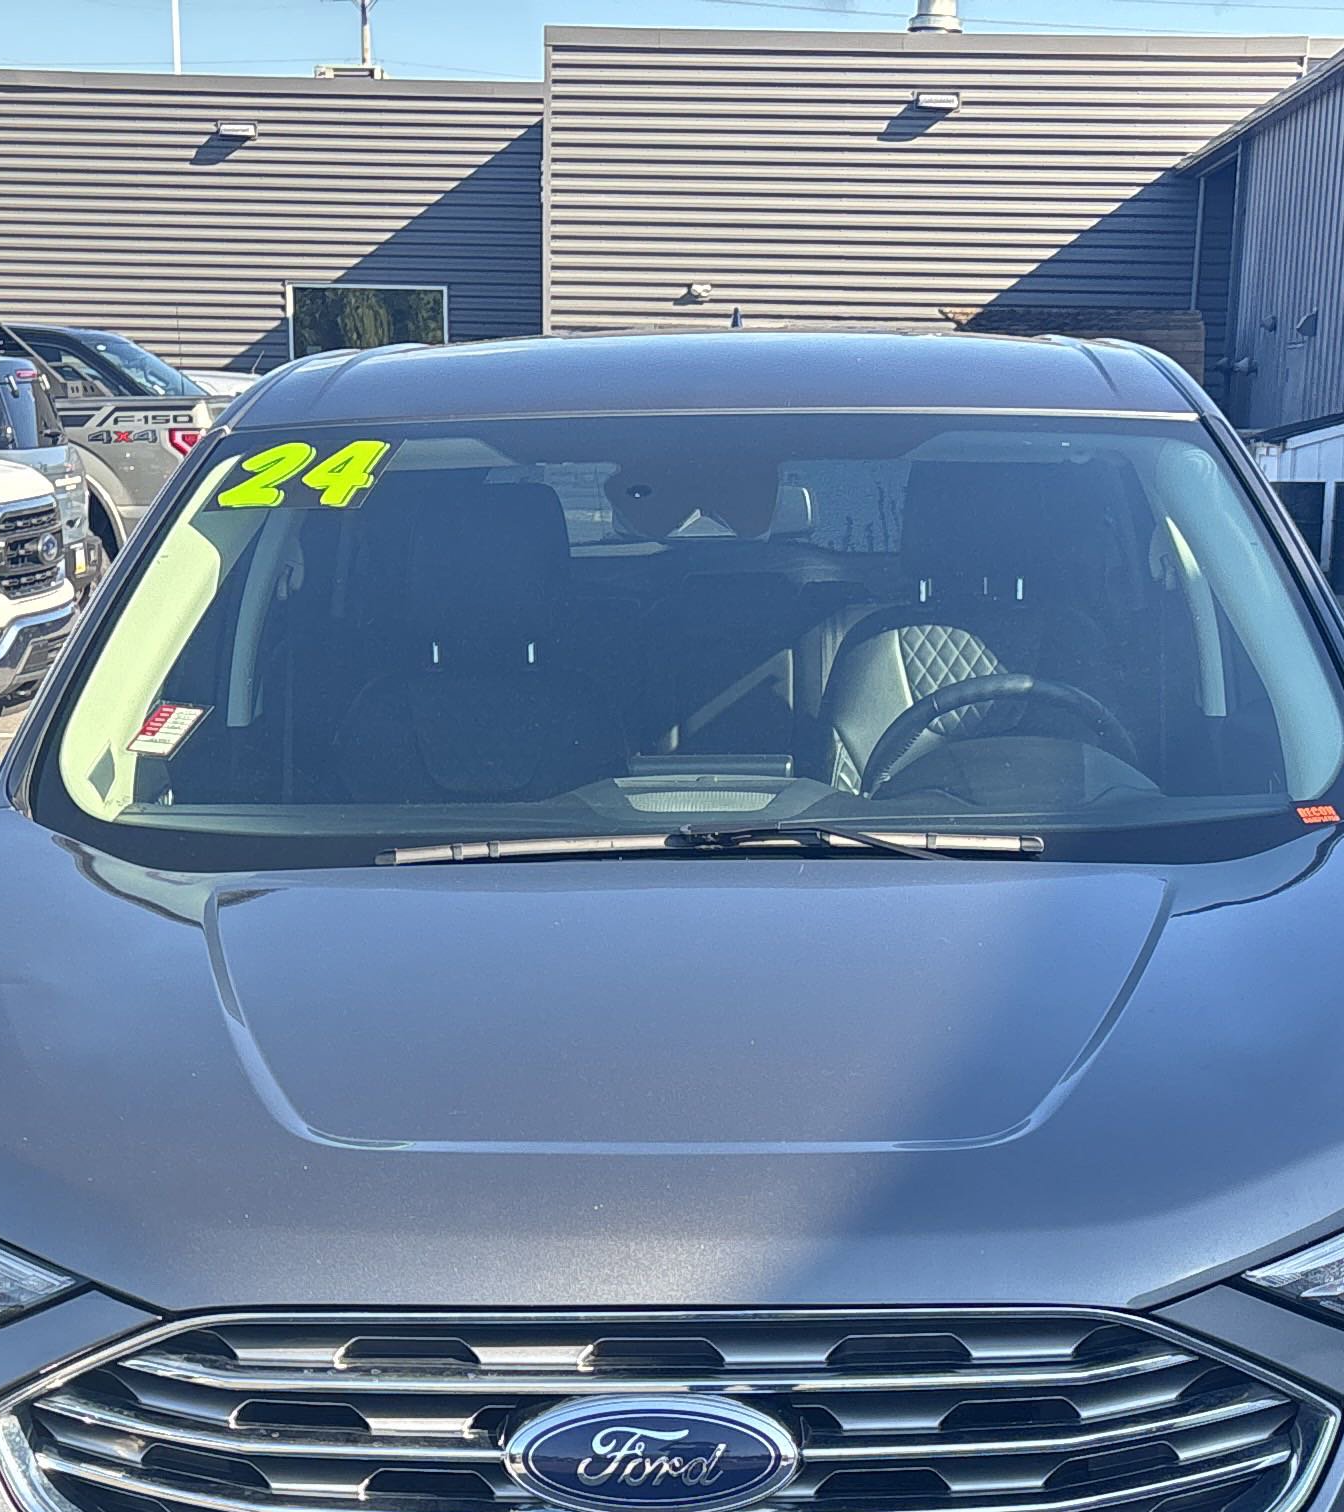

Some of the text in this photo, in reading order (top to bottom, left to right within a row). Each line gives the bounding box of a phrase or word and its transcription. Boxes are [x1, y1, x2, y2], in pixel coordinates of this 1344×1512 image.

[112, 414, 194, 426] F-150
[217, 440, 391, 508] 24
[576, 1425, 728, 1488] Ford
